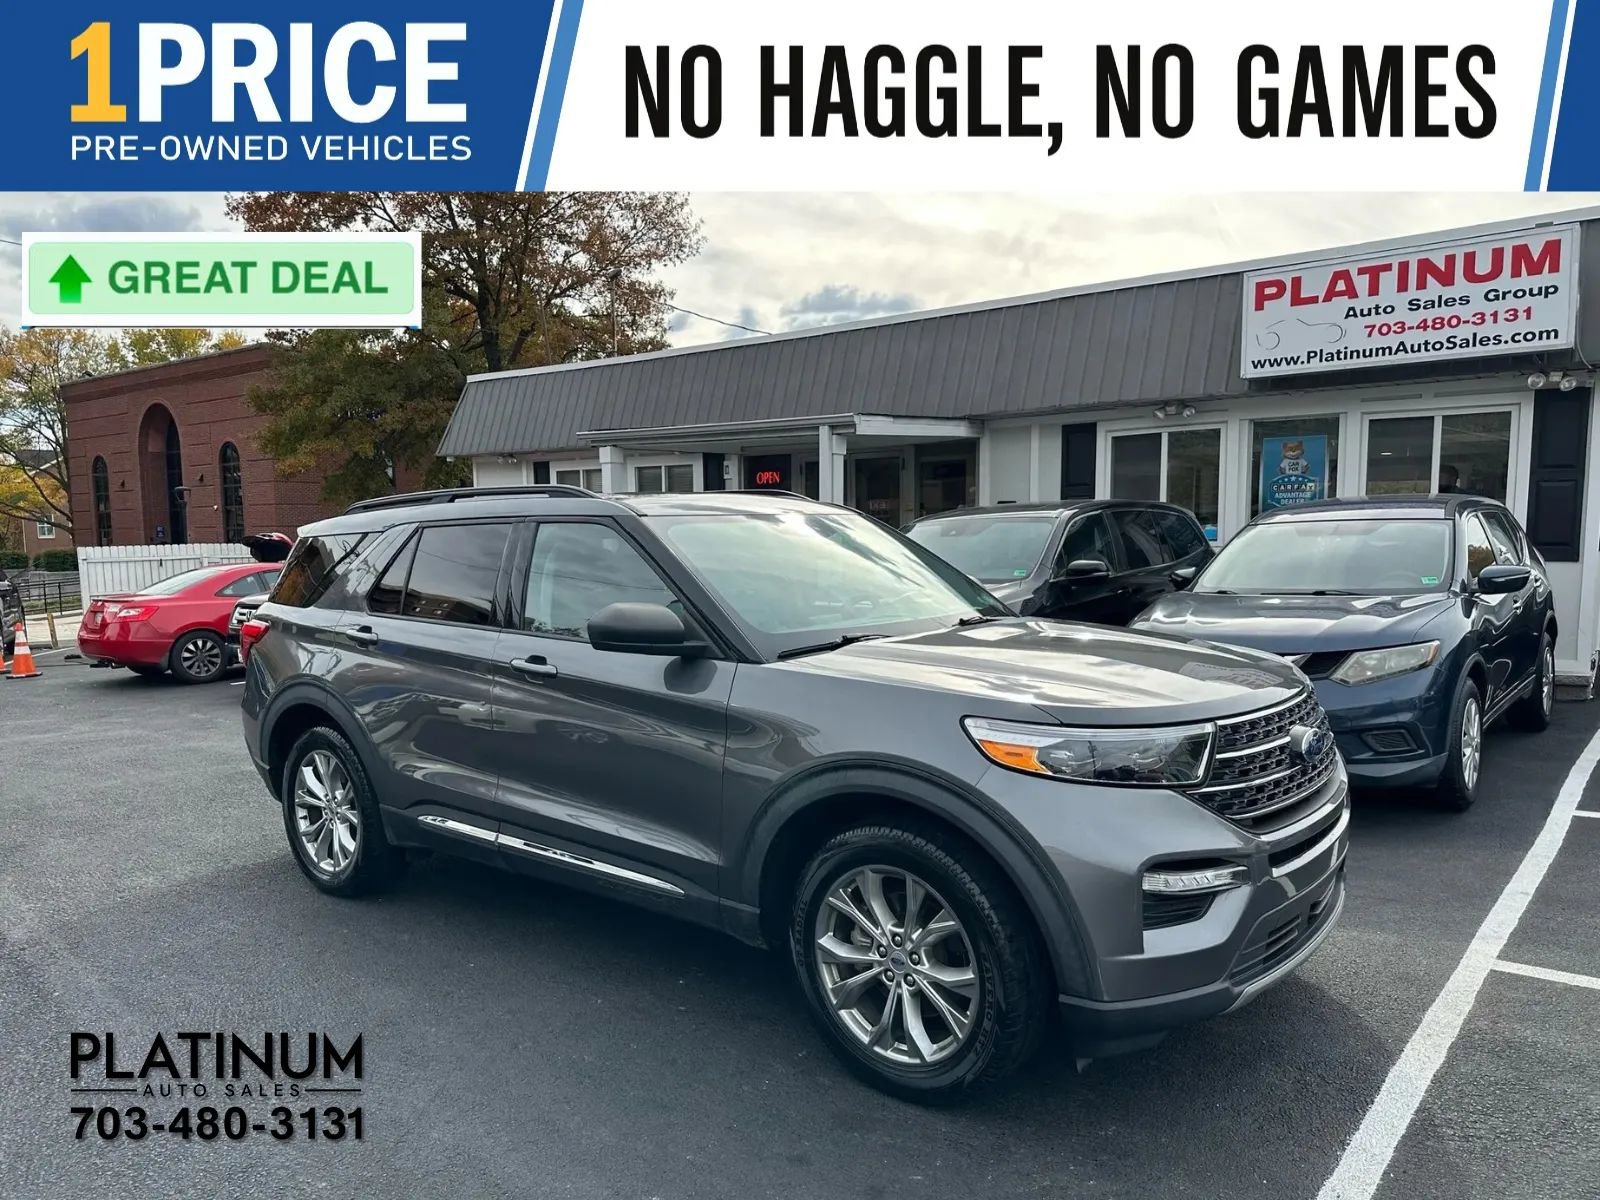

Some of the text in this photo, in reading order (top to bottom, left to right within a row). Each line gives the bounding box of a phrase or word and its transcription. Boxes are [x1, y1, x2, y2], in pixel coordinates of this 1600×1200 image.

[1254, 238, 1562, 312] PLATINUM
[1344, 283, 1559, 319] Auto Sales Group
[1364, 306, 1533, 338] 703-480-3131
[1251, 328, 1559, 370] www.PlatinumAutoSales.com
[756, 471, 780, 485] OPEN
